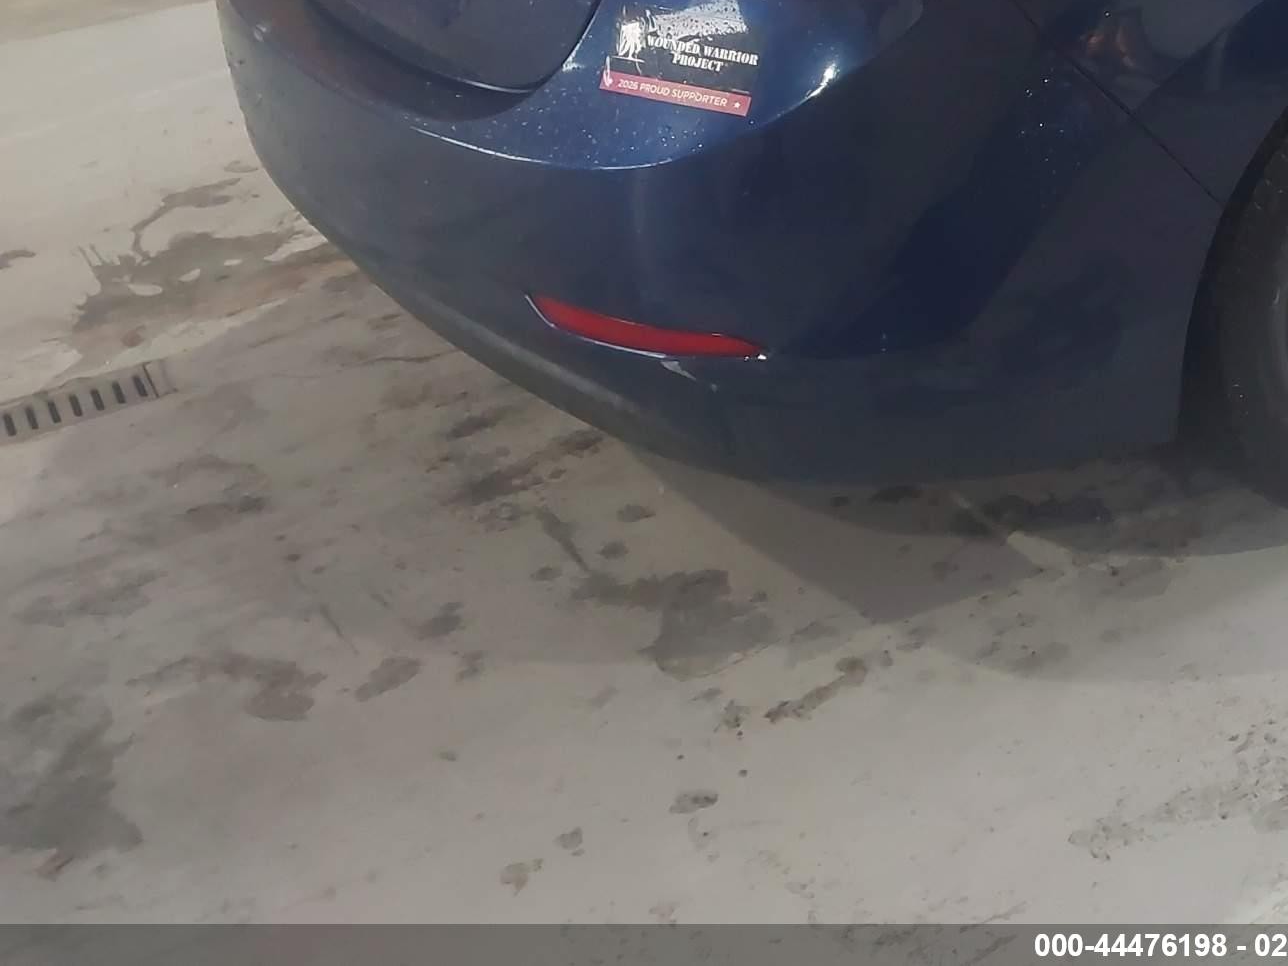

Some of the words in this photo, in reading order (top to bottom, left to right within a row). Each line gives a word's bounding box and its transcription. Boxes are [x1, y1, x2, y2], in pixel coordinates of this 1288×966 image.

[647, 34, 701, 55] WOUNDED
[704, 45, 759, 66] WARRIOR
[671, 51, 724, 72] PROJECT
[639, 82, 670, 96] PROUD
[671, 88, 728, 107] SUPPORTER
